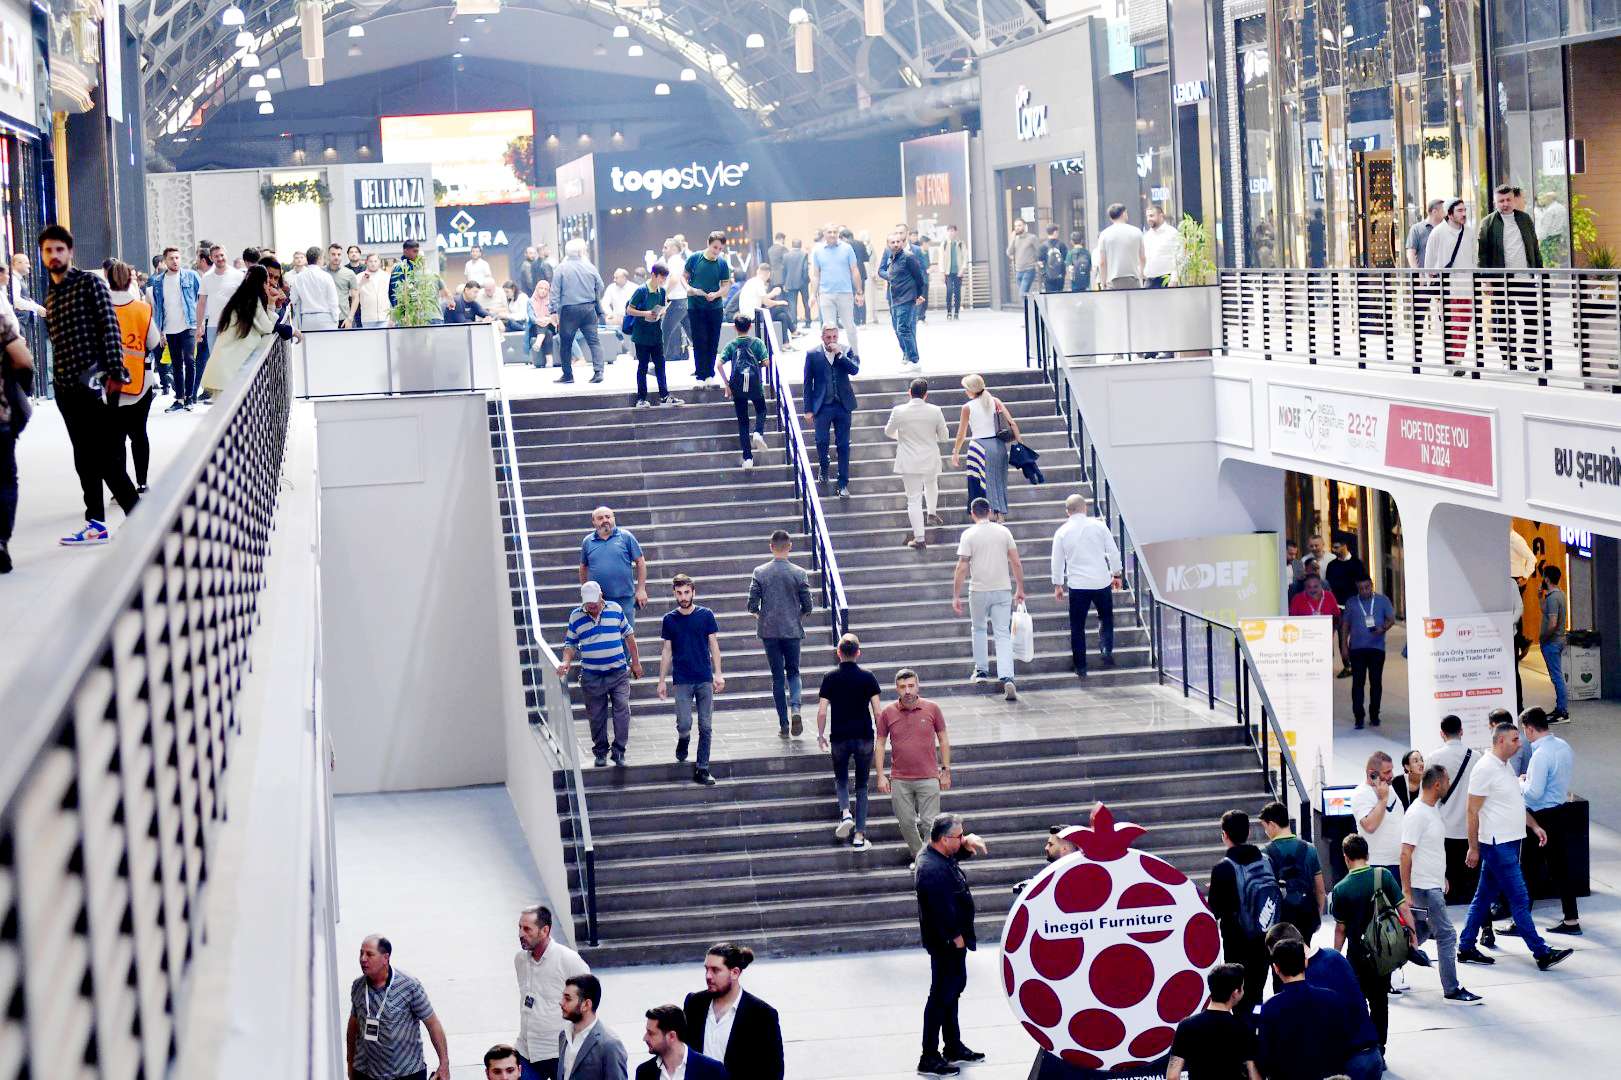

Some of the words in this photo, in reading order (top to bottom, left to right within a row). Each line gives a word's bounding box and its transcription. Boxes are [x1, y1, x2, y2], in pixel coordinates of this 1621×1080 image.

[611, 160, 749, 199] togostyle
[1348, 412, 1378, 438] 22-27
[1400, 418, 1422, 441] HOPE
[1422, 421, 1435, 443] TO
[1435, 424, 1451, 446] SEE
[1450, 426, 1469, 449] YOU
[1421, 443, 1430, 464] IN
[1431, 444, 1451, 468] 2024
[1554, 447, 1573, 478] BU
[1166, 560, 1250, 592] MODEF
[1450, 648, 1464, 656] Only
[1465, 646, 1503, 654] International
[1045, 919, 1094, 935] İnegöl
[1099, 914, 1173, 930] Furniture
[1259, 896, 1276, 929] NIKE
